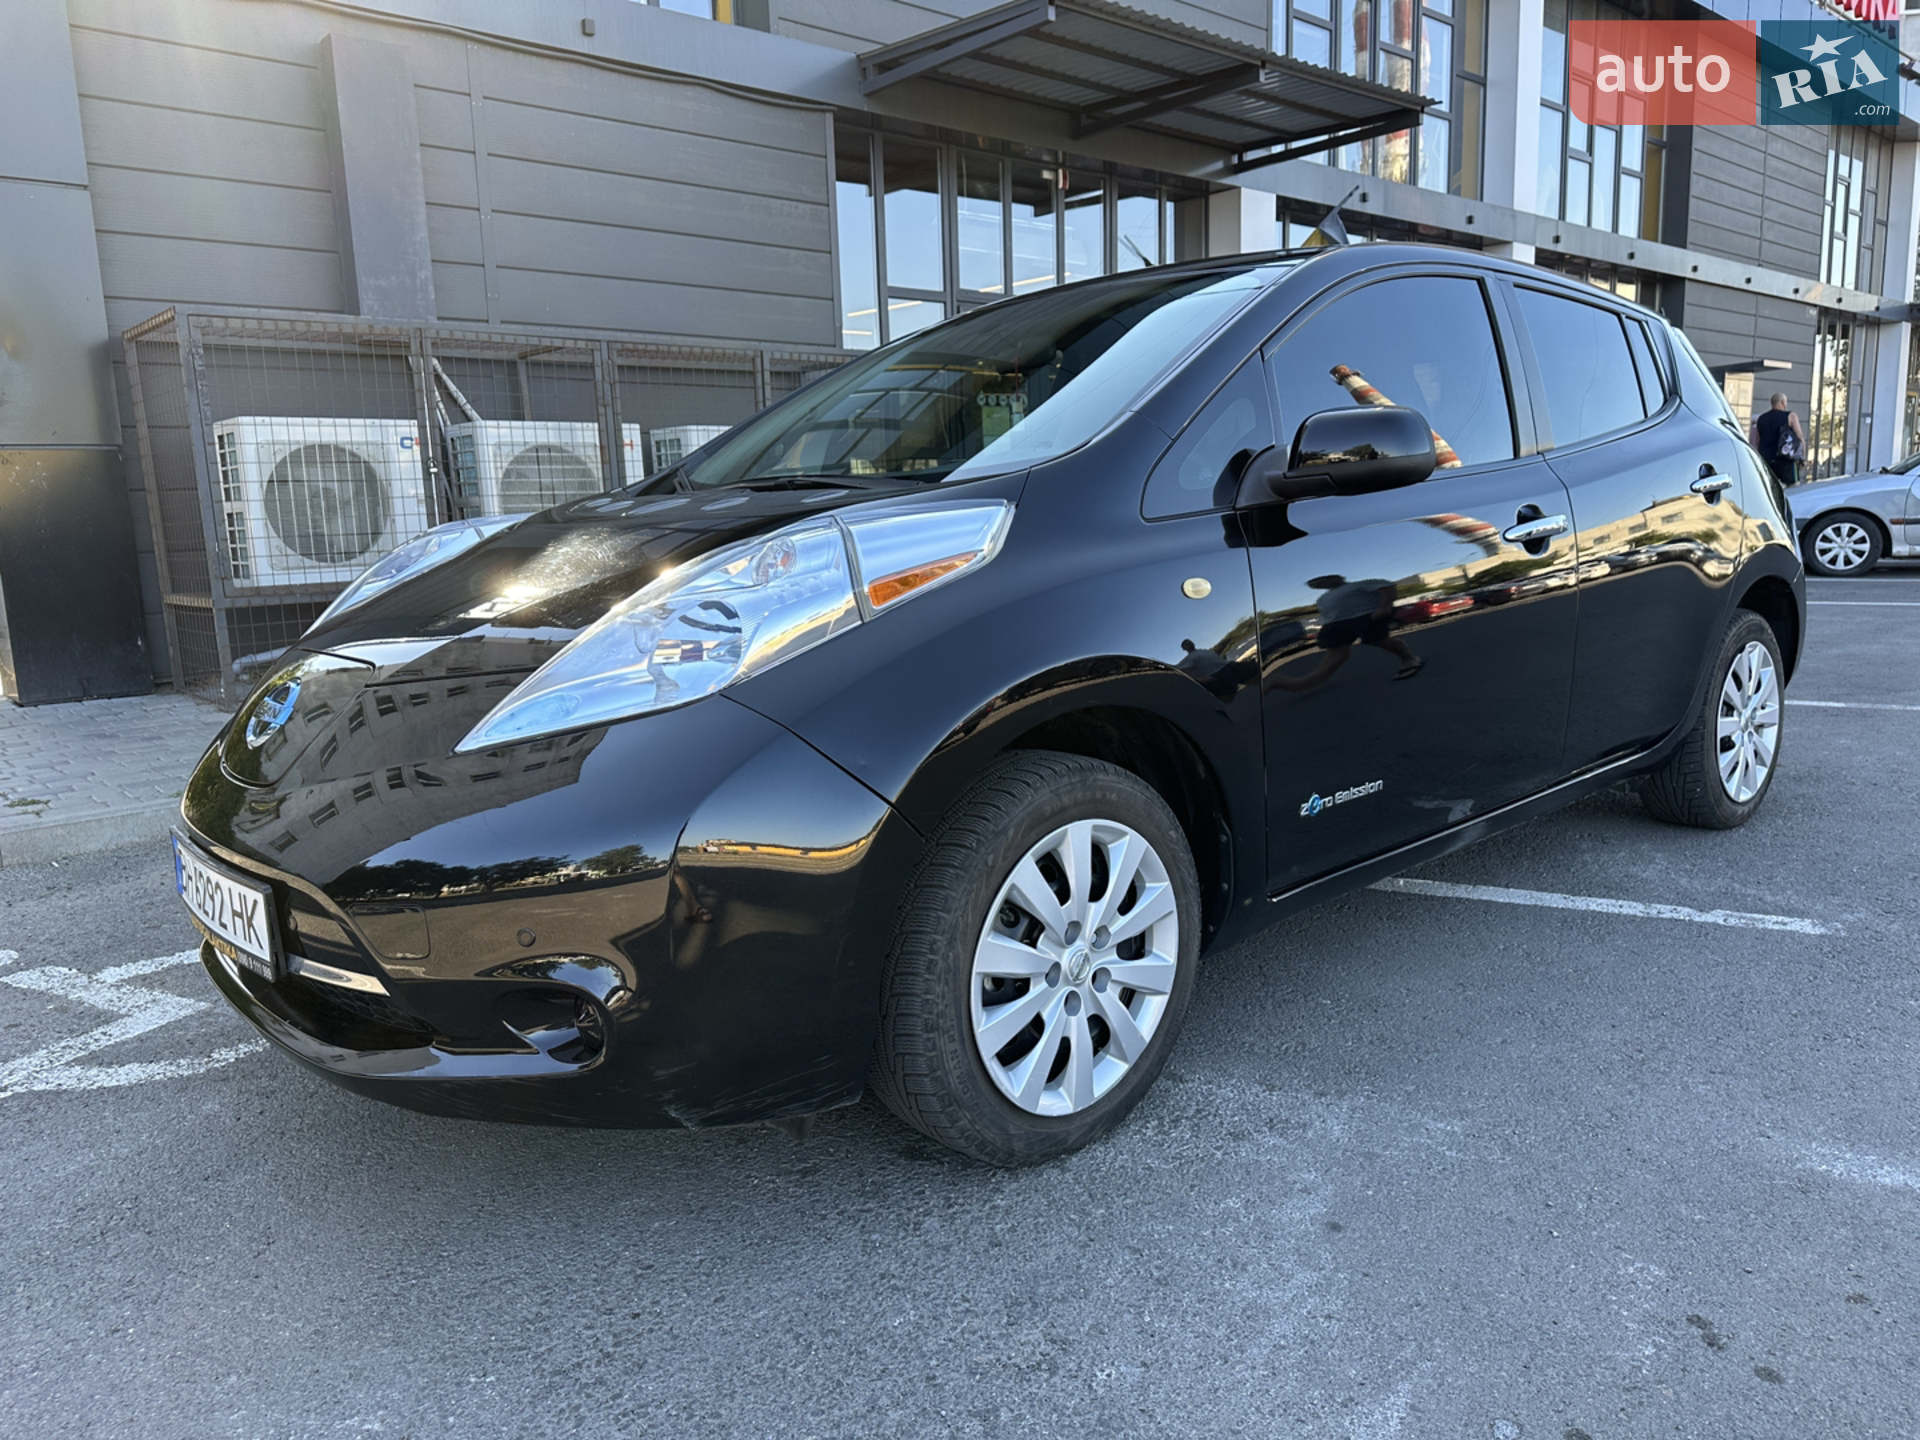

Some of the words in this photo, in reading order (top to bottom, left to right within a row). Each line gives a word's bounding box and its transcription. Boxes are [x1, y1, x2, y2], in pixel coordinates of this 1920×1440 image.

[1334, 779, 1383, 804] Emission
[194, 866, 229, 932] 6292
[228, 887, 263, 950] HK
